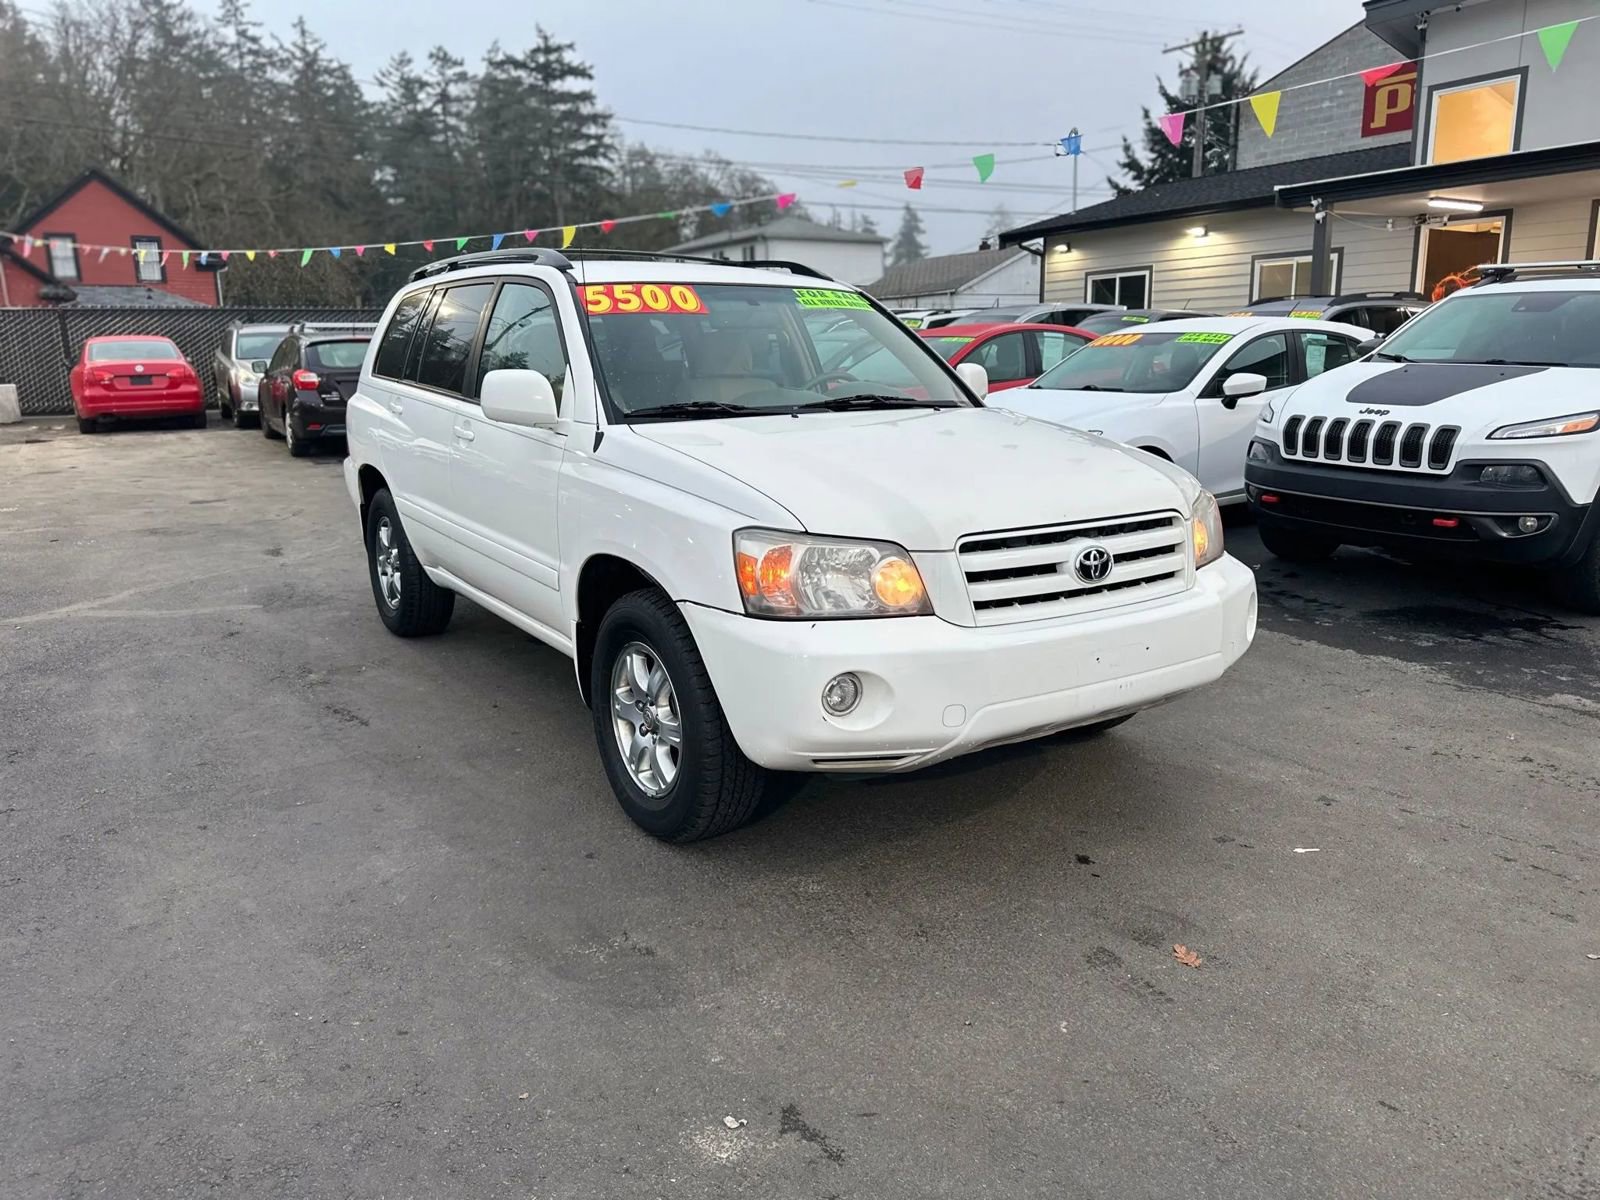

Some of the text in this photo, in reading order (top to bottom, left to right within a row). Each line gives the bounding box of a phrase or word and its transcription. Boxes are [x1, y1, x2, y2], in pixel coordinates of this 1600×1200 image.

[797, 290, 829, 298] FOR
[585, 284, 700, 313] 5500
[1359, 408, 1390, 416] Jeep
